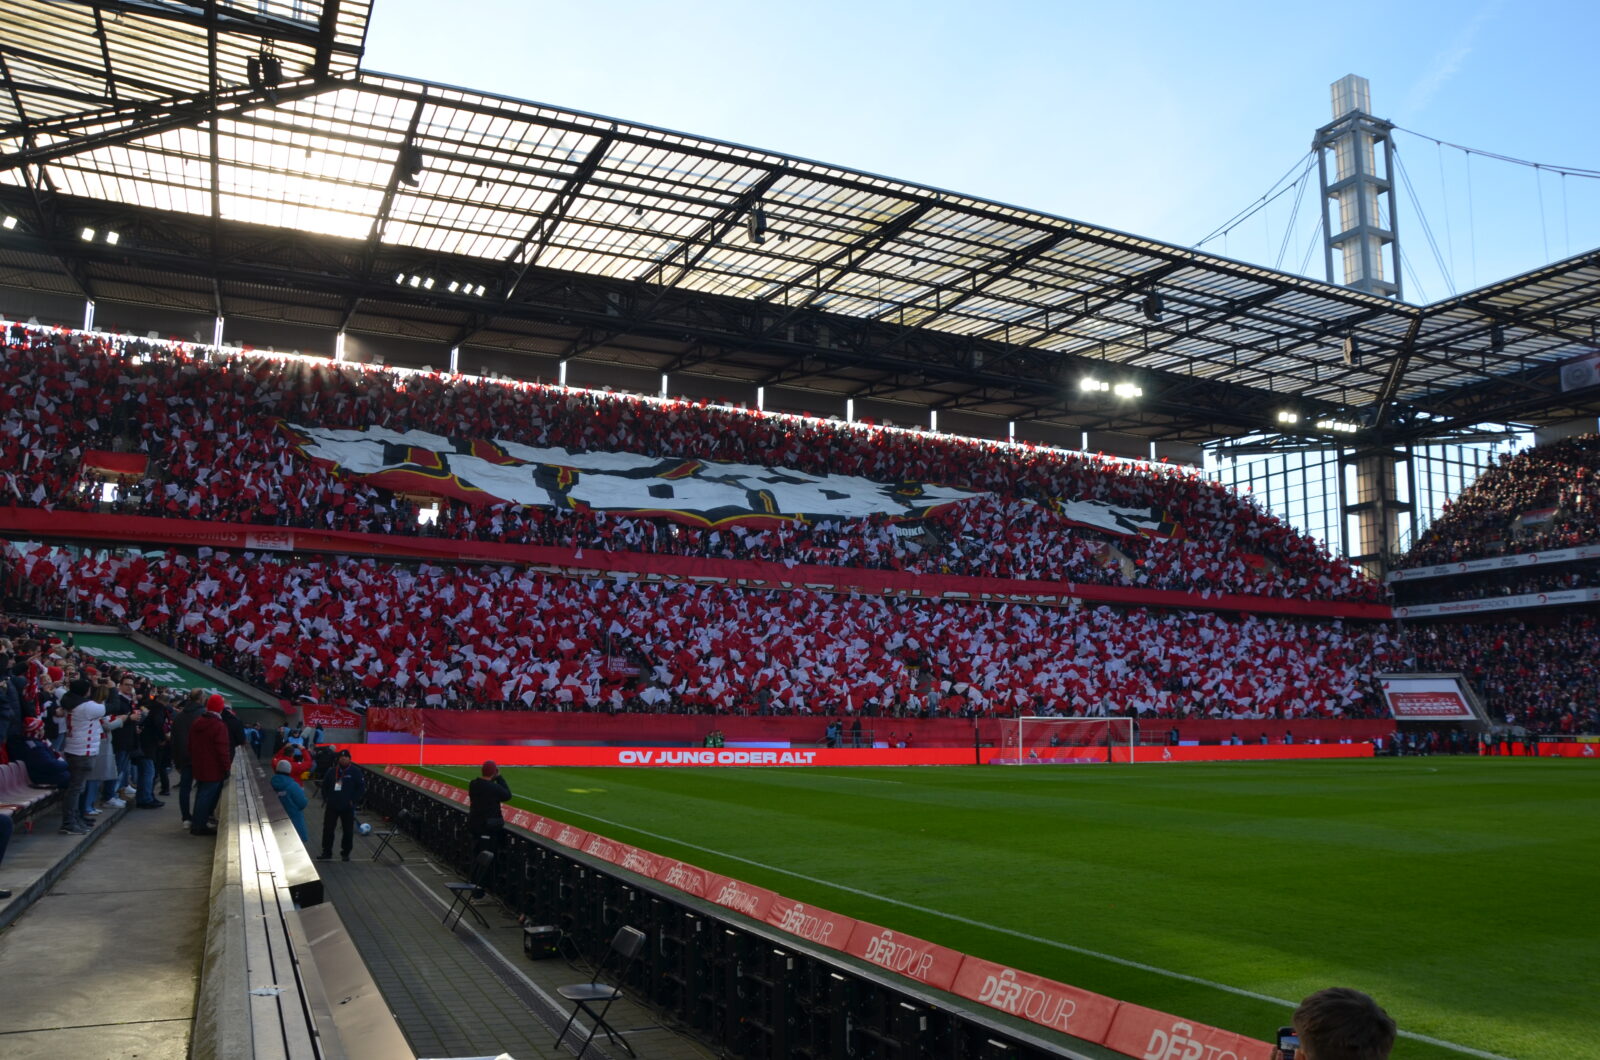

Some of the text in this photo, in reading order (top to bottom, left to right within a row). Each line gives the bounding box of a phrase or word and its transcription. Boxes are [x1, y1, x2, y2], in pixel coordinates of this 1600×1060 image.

[79, 645, 137, 659] Mer
[618, 750, 817, 764] OV JUNG ODER ALT
[780, 909, 834, 945] DERTOUR
[865, 936, 933, 980] DERTOUR
[978, 975, 1076, 1030] DERTOUR
